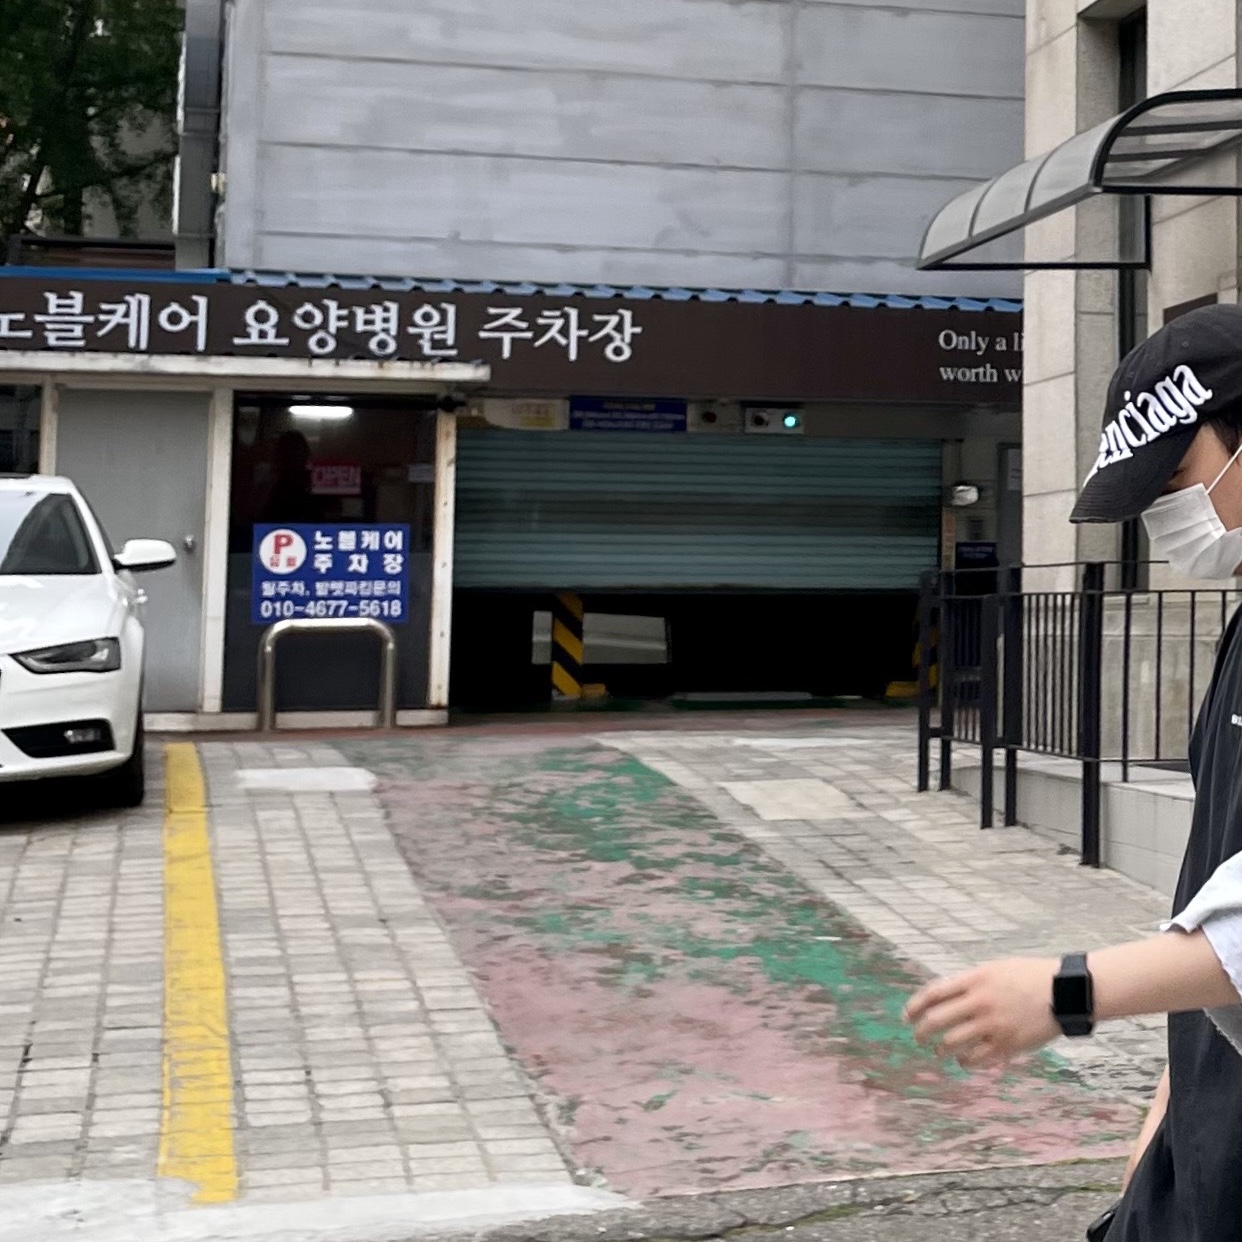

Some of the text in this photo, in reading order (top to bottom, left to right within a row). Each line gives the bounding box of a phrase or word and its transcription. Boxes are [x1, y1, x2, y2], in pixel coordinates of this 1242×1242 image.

[233, 299, 458, 356] 요양병원
[478, 306, 643, 362] 주차장
[938, 328, 990, 356] Only
[995, 336, 1007, 351] a
[939, 362, 999, 383] worth
[260, 599, 402, 618] 010-4677-5618
